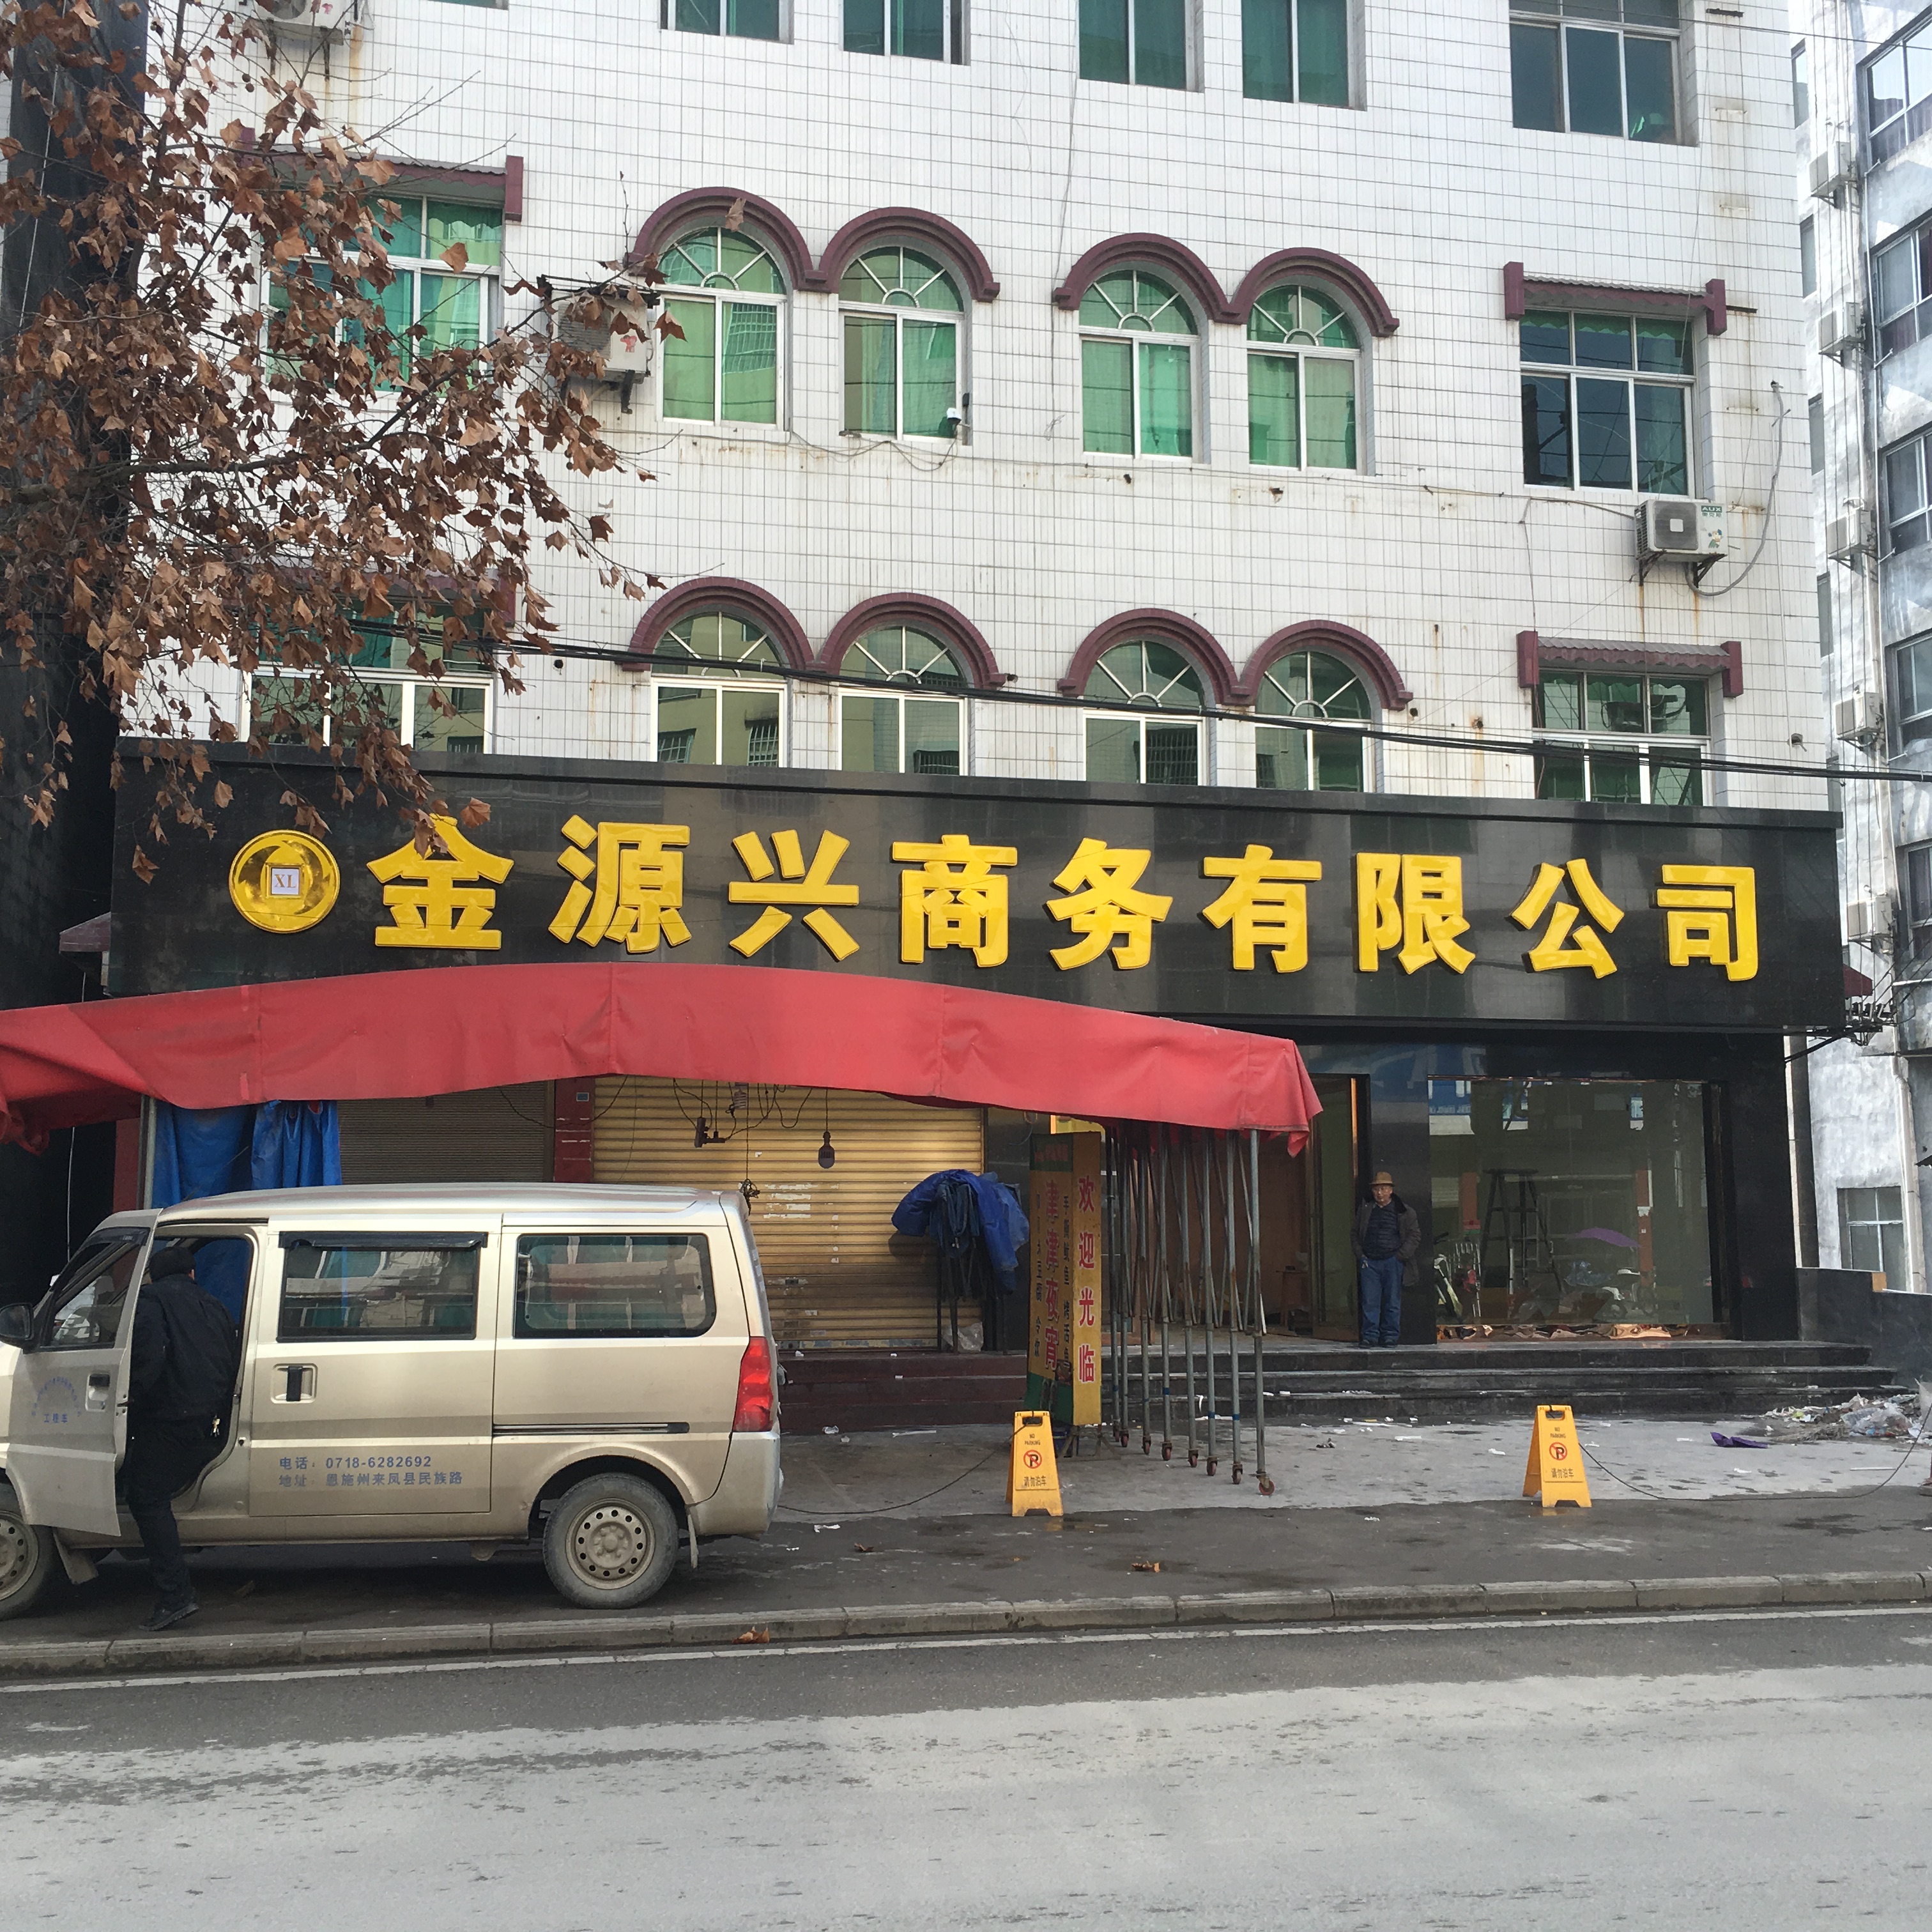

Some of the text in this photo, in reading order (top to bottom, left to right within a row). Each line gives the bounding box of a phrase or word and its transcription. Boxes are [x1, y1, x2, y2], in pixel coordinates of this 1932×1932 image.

[275, 874, 297, 888] XL
[367, 813, 1759, 982] 金源兴商务有限公司
[1078, 1175, 1095, 1383] 欢迎光临
[325, 1456, 431, 1469] 0718-6282692
[326, 1471, 463, 1486] 恩施州来凤县民族路
[1023, 1475, 1047, 1487] 请勿泊车
